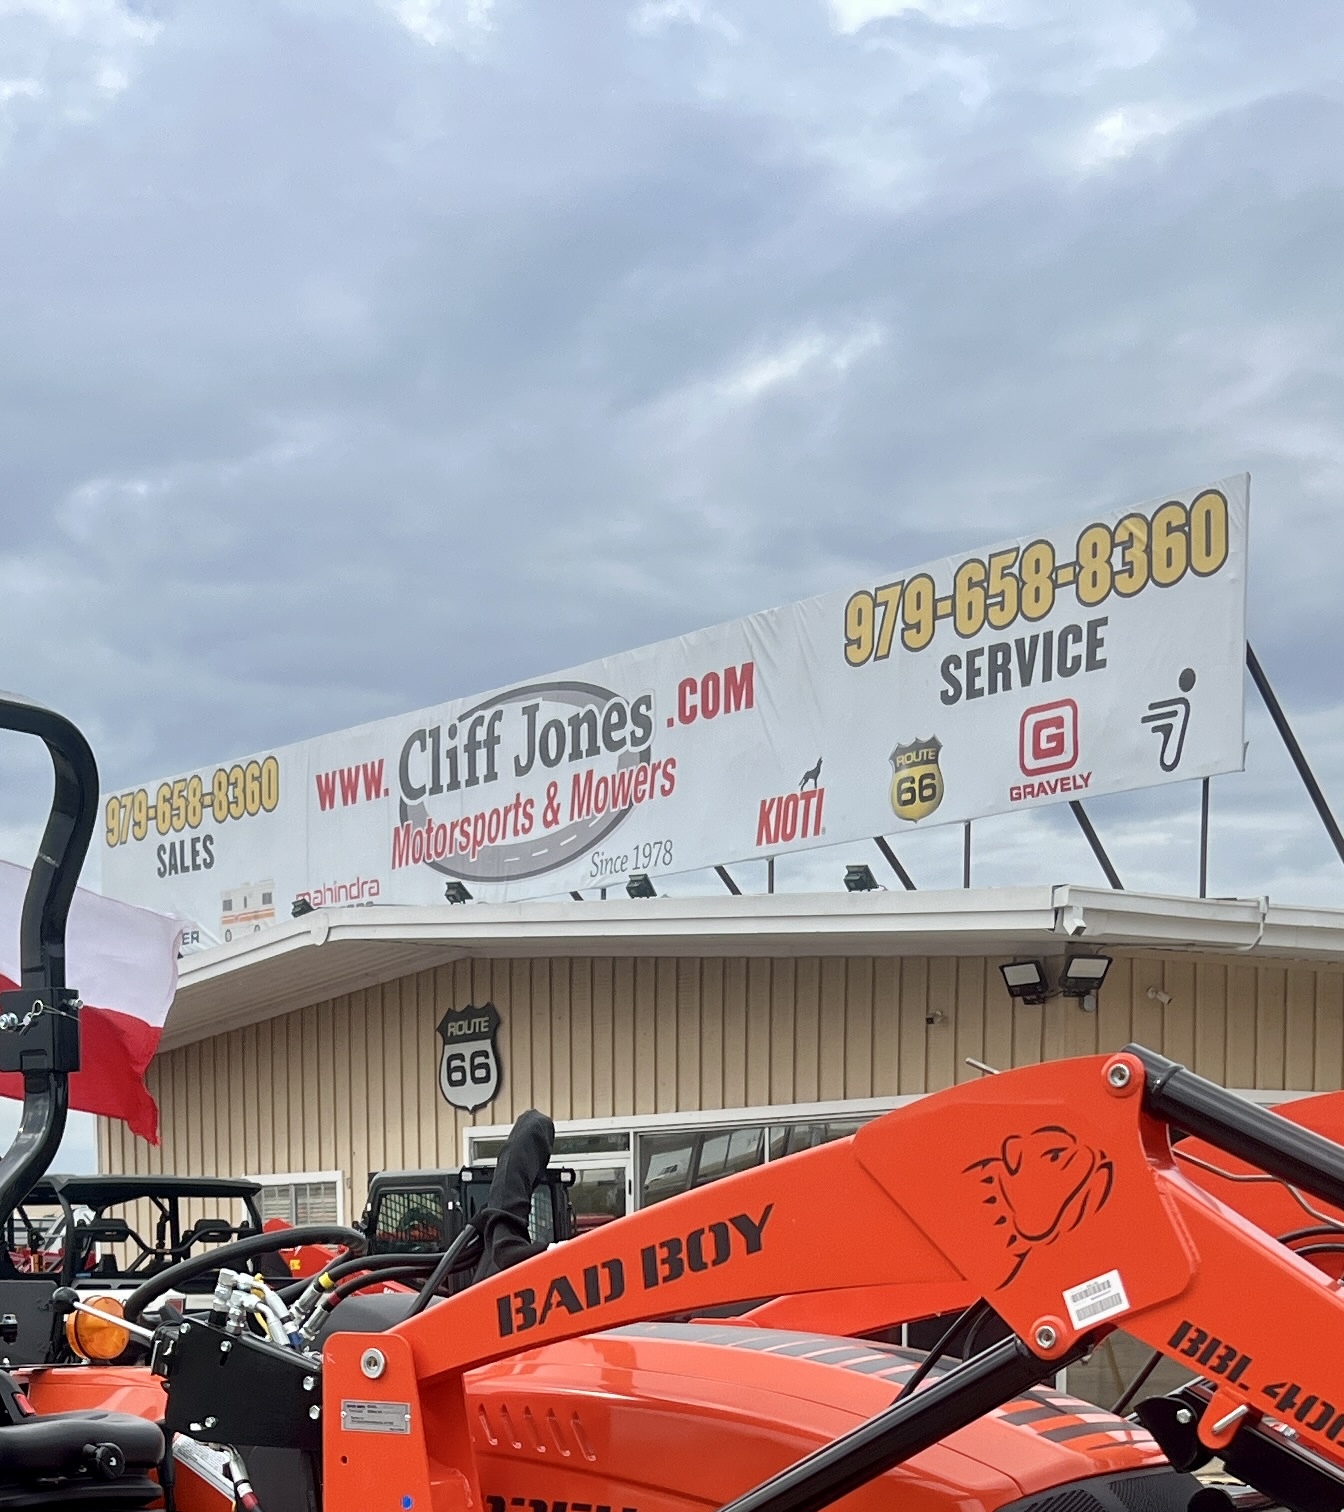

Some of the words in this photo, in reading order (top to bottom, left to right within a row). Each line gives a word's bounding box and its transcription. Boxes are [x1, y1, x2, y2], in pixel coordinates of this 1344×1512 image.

[844, 489, 1229, 667] 979-658-8360
[940, 617, 1109, 705] SERVICE
[399, 707, 503, 803] Cliff
[514, 694, 652, 778] Jones
[666, 662, 754, 728] .COM
[896, 748, 936, 766] ROUTE
[105, 756, 280, 848] 979-658-8360
[896, 773, 936, 807] 66
[1010, 772, 1092, 802] GRAVELY
[391, 795, 533, 870] Motorsports
[541, 781, 560, 829] &
[569, 757, 677, 820] Mowers
[756, 788, 825, 847] KIOTI
[157, 834, 214, 878] SALES
[589, 849, 629, 878] Since
[631, 839, 674, 872] 1978
[296, 876, 380, 907] mahindra
[181, 930, 200, 945] ER
[447, 1016, 490, 1037] ROUTE
[446, 1049, 491, 1088] 66
[497, 1258, 626, 1339] BAD
[640, 1203, 775, 1289] BOY
[1167, 1321, 1257, 1392] BBL
